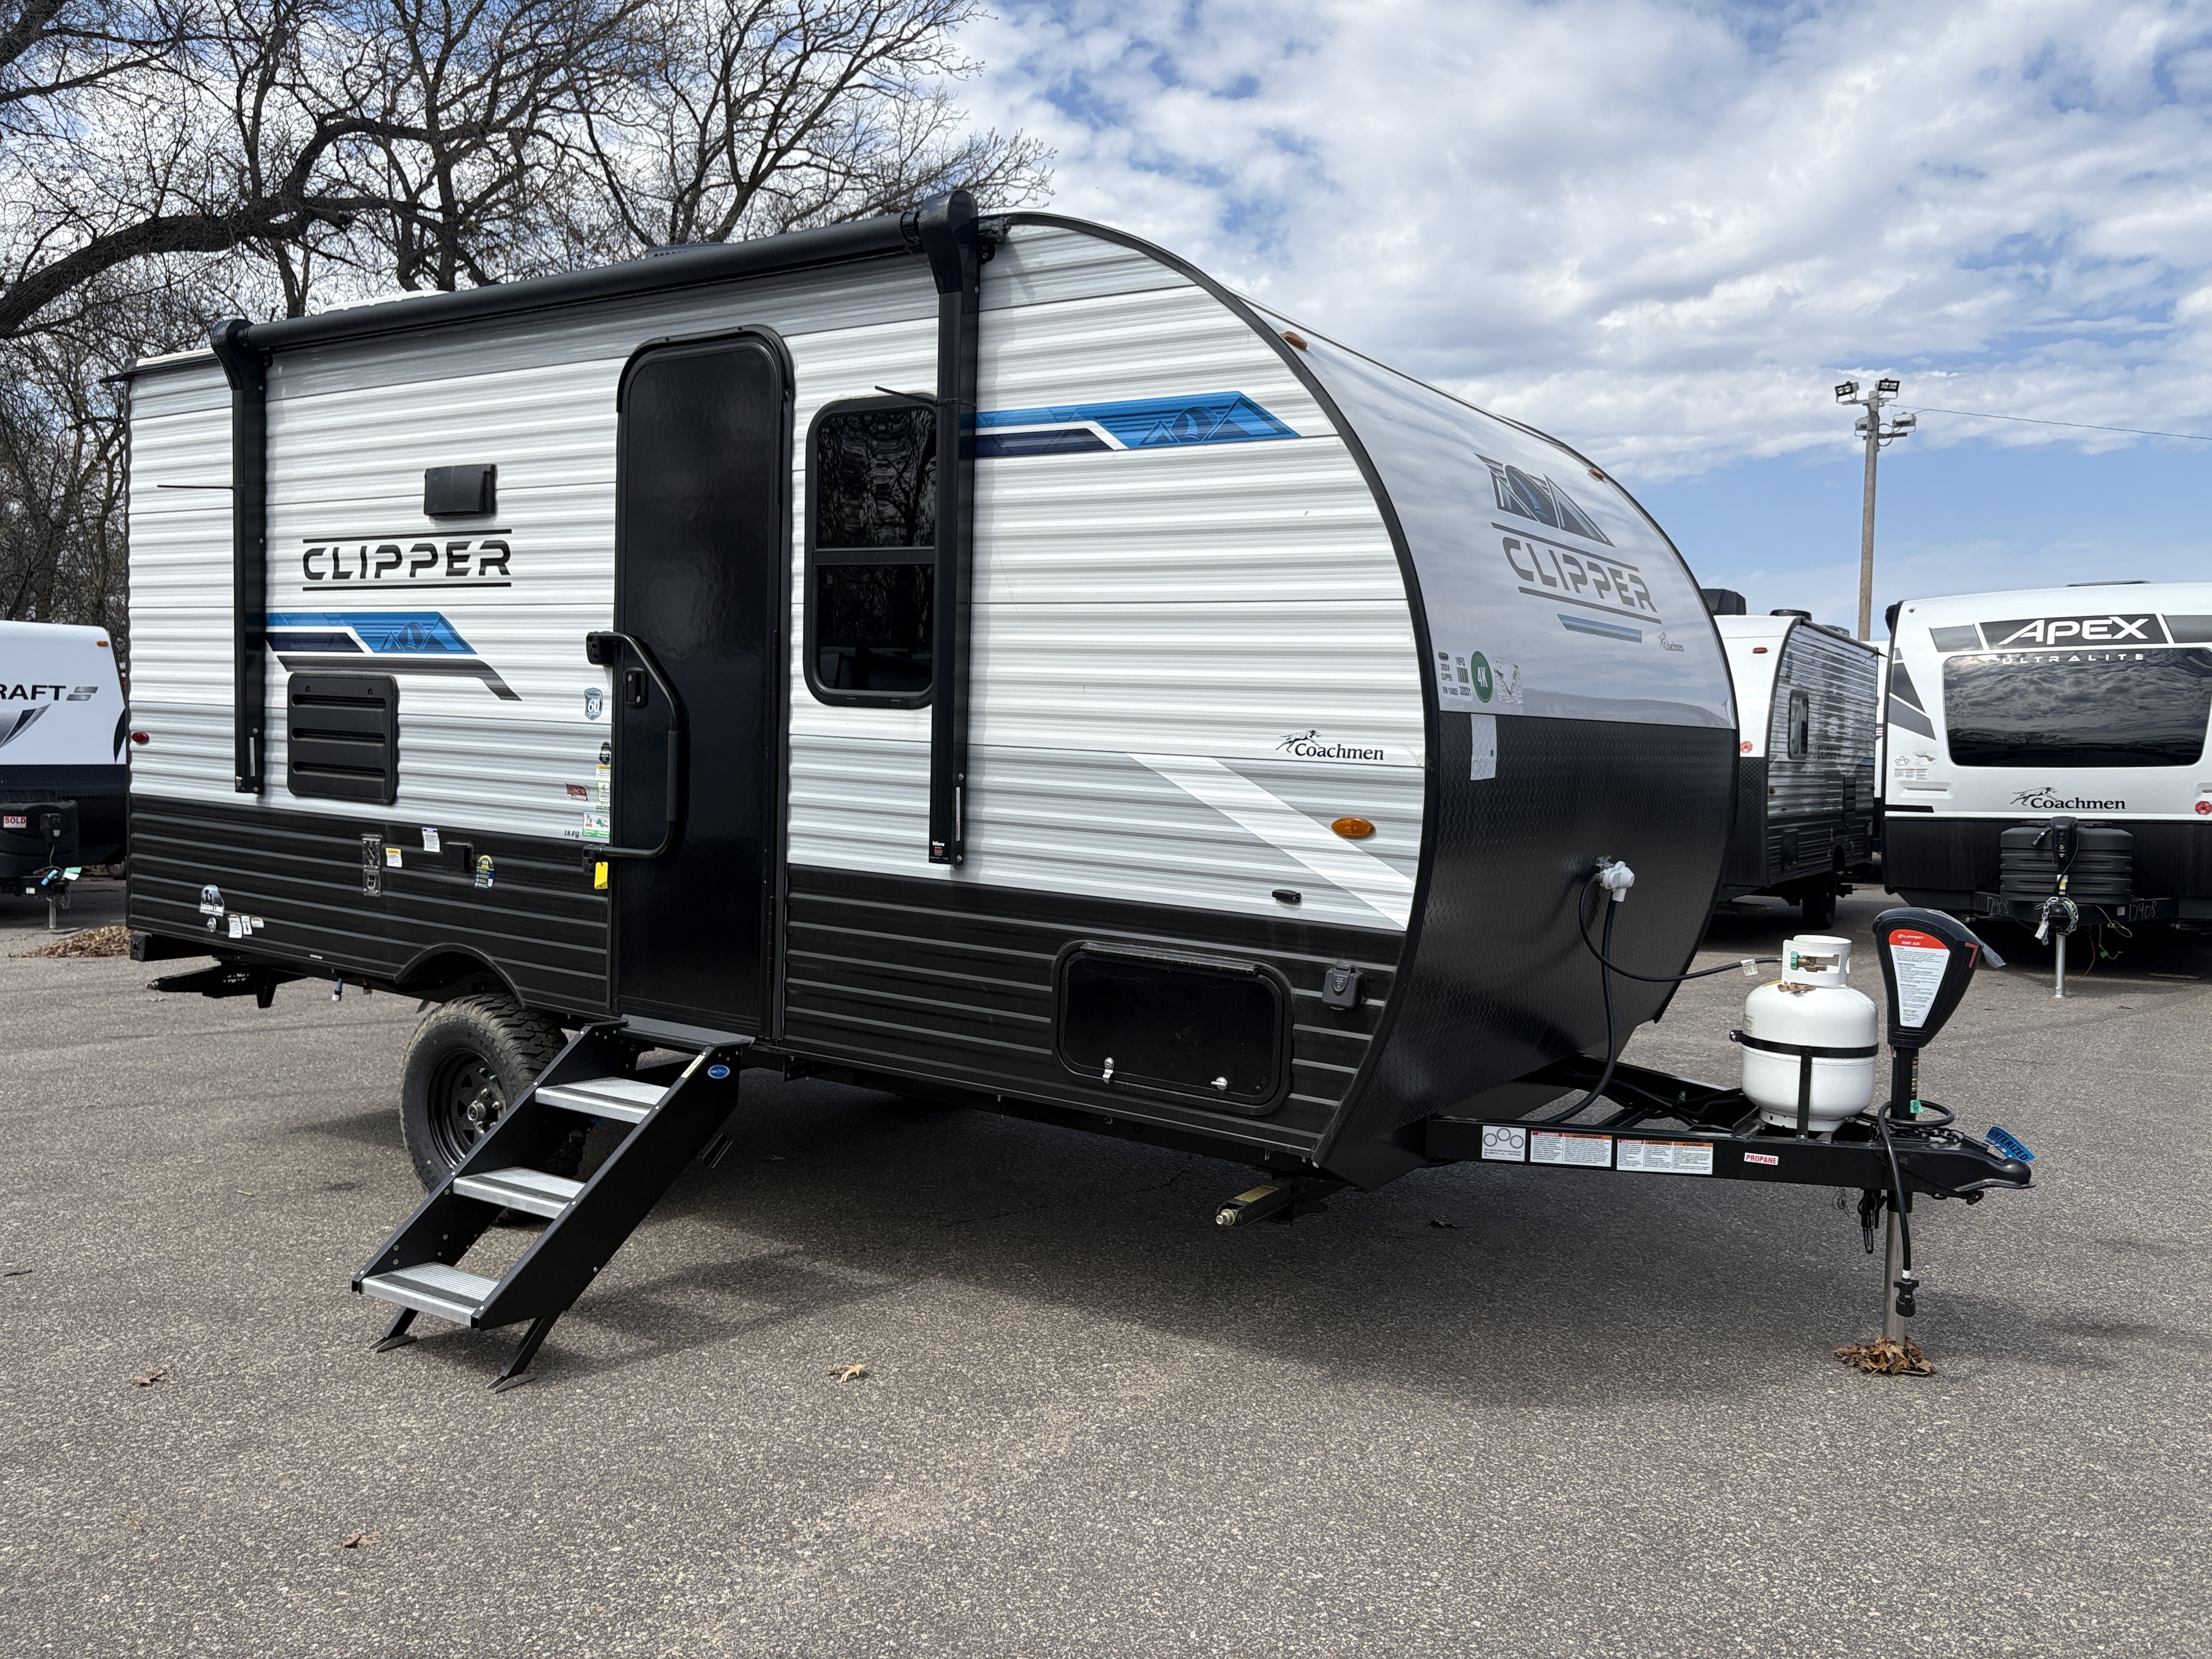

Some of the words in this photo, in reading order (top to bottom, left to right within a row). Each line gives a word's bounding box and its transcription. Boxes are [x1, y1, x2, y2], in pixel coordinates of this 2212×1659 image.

[303, 540, 512, 580] CLIPPER
[1502, 537, 1658, 613] CLIPPER
[1997, 616, 2150, 645] APEX
[2002, 653, 2145, 665] ULTRALITE
[1477, 666, 1488, 689] 4K
[588, 698, 600, 713] 60
[1294, 743, 1384, 761] Coachmen
[2030, 797, 2126, 810] Coachmen
[1746, 1154, 1777, 1164] PROPANE
